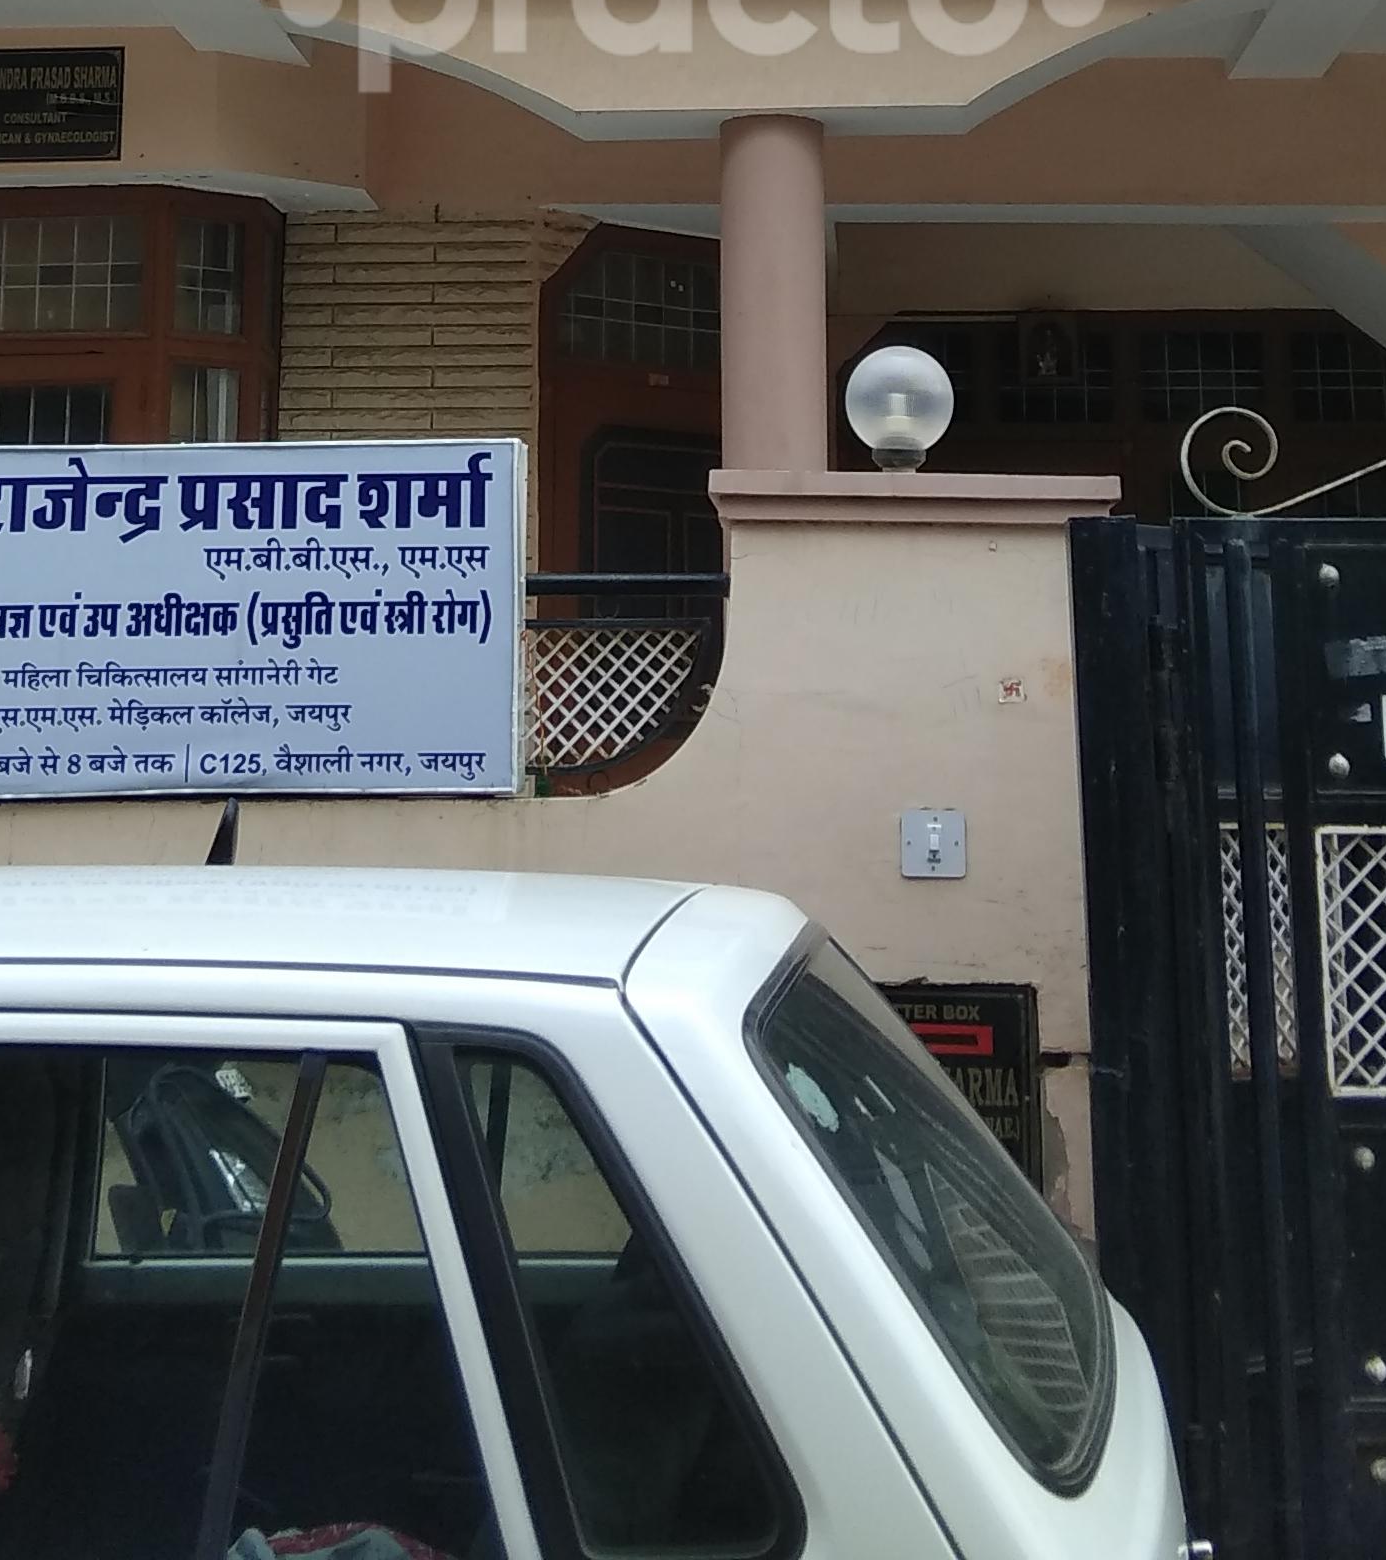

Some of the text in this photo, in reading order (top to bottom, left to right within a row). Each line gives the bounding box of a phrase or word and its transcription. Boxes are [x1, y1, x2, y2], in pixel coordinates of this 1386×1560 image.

[30, 66, 69, 89] PRASAD
[73, 64, 116, 88] SHARMA
[3, 112, 66, 125] CONSULTANT
[24, 132, 31, 144] &
[34, 130, 114, 144] GYNAECOLOGIST
[177, 473, 348, 531] प्रसाद
[356, 451, 492, 529] शर्मा
[397, 545, 489, 579] एम.एस
[38, 591, 81, 637] एवं
[83, 603, 121, 638] उप
[125, 593, 239, 637] अधीक्षक
[339, 588, 381, 634] एवं
[384, 590, 427, 635] स्त्री
[431, 588, 491, 644] रोग)
[0, 658, 338, 690] महिला चिकित्सालय सांगानेरी गेट
[198, 695, 278, 728] कॉलेज,
[285, 704, 351, 732] जयपुर
[38, 746, 61, 774] से
[66, 753, 81, 774] 8
[86, 745, 127, 774] बजे
[132, 752, 175, 774] तक
[199, 752, 266, 777] C125,
[273, 743, 353, 775] वैशाली
[356, 752, 410, 777] नगर,
[417, 751, 486, 780] जयपुर
[943, 1004, 980, 1020] BOX
